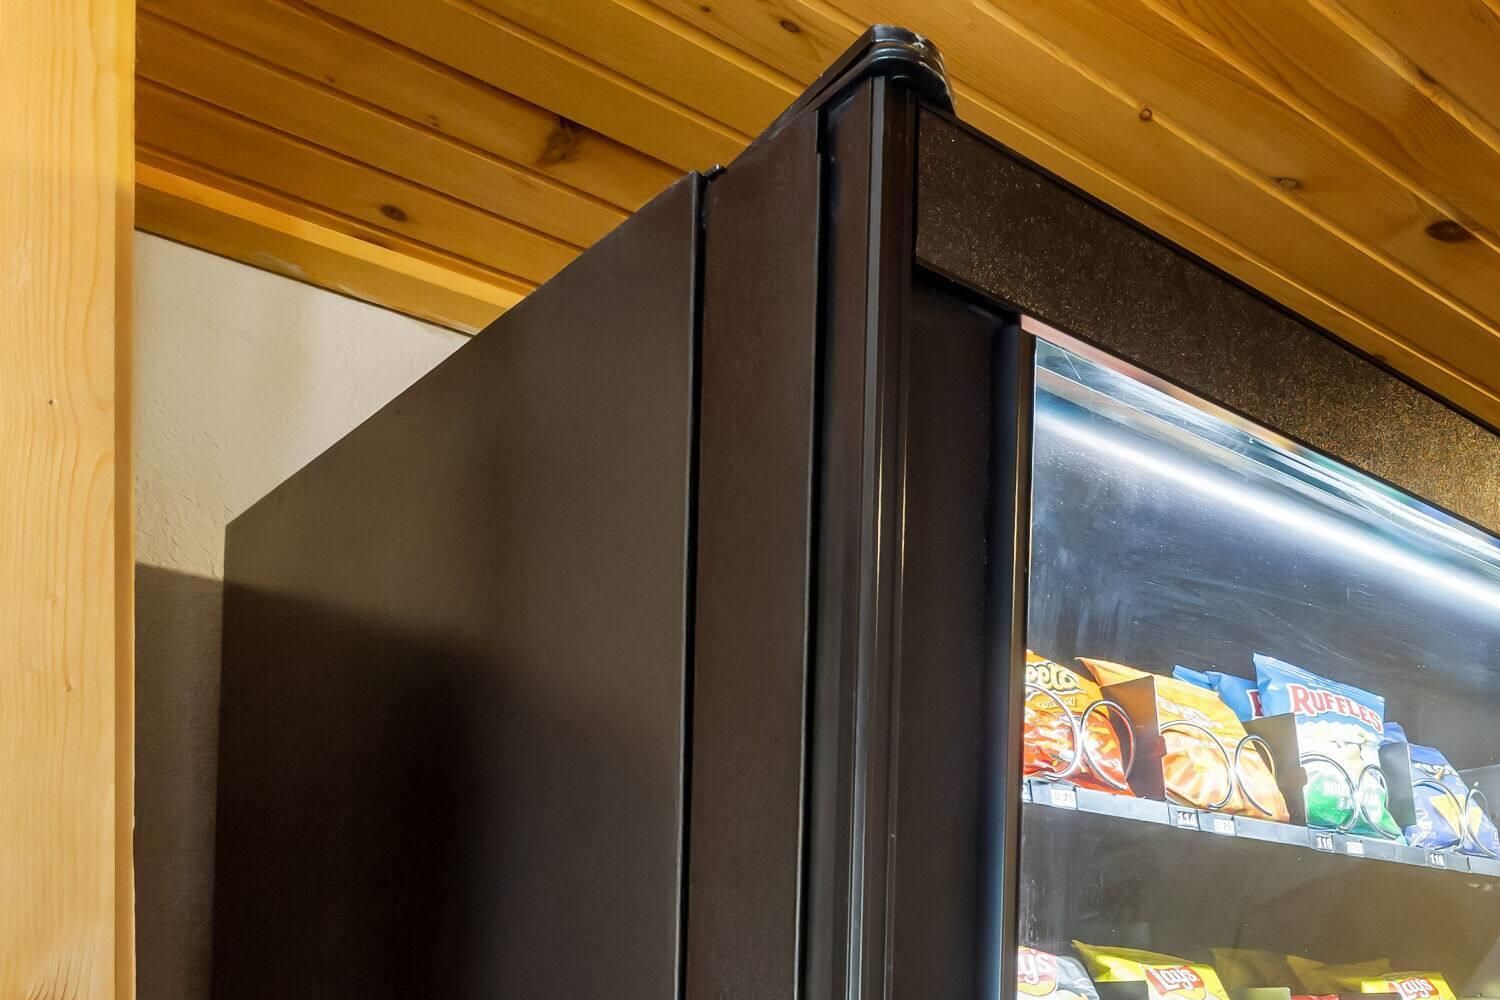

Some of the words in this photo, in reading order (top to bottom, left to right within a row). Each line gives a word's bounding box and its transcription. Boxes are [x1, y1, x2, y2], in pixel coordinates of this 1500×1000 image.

[1287, 683, 1384, 736] RUFFLES
[1316, 836, 1332, 850] 116
[1149, 965, 1200, 991] Lay's
